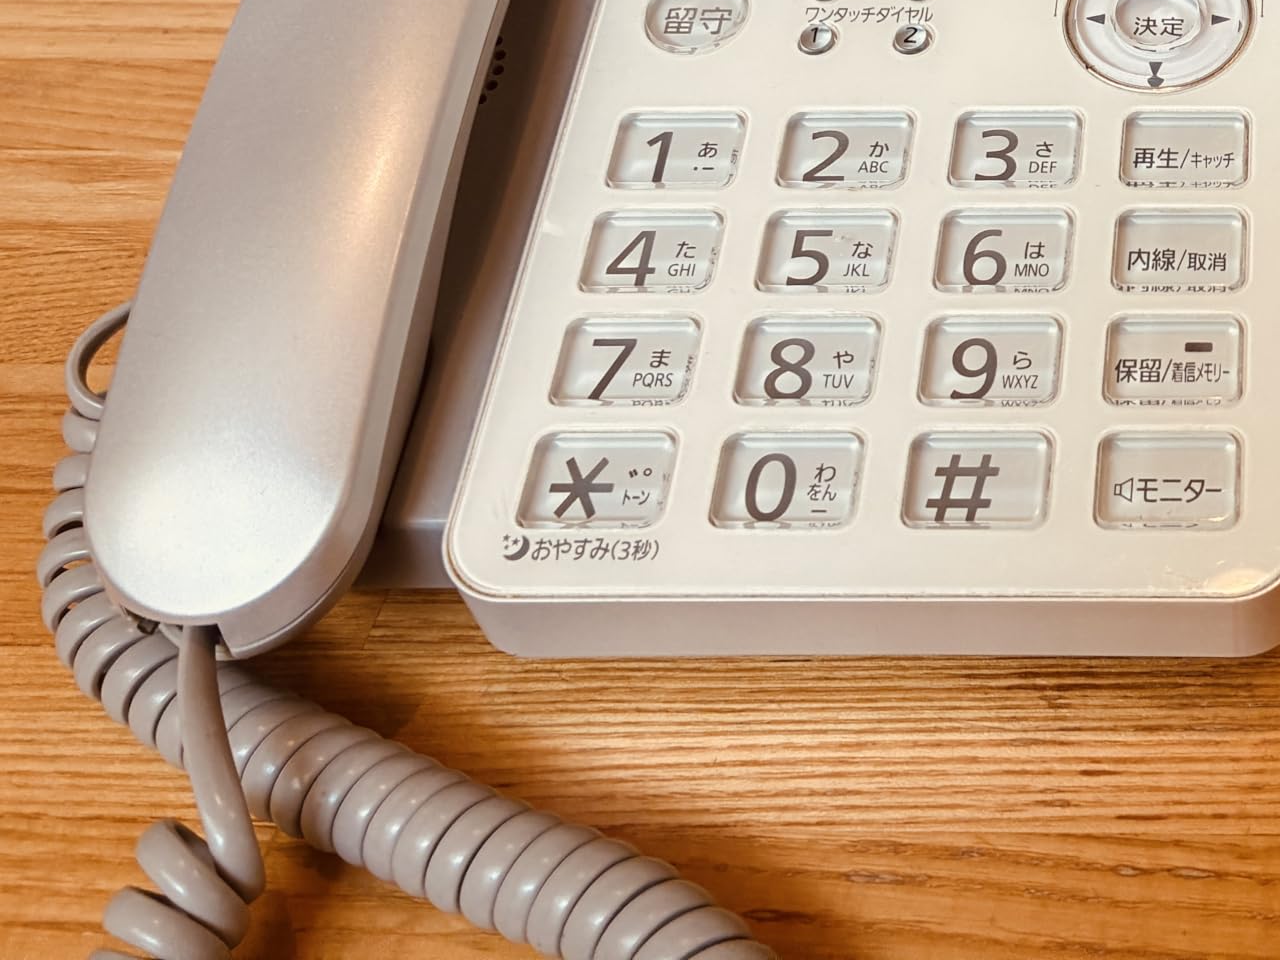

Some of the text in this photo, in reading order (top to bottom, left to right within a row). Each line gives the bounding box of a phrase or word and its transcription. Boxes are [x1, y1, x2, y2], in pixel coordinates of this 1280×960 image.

[664, 6, 732, 34] 留守
[804, 6, 933, 23] ワンタッチダイヤル
[810, 27, 819, 43] 1
[903, 27, 918, 43] 2
[1132, 16, 1185, 37] 決定
[646, 131, 674, 183] 1
[698, 142, 718, 158] あ
[802, 130, 850, 182] 2
[869, 141, 889, 158] か
[974, 129, 1019, 181] 3
[1035, 141, 1054, 158] さ
[1132, 147, 1235, 170] 再生/キャッチ
[858, 160, 889, 174] ABC
[1028, 160, 1057, 174] DEF
[605, 230, 656, 286] 4
[676, 241, 696, 259] た
[786, 229, 833, 286] 5
[852, 241, 873, 259] な
[963, 229, 1007, 286] 6
[1023, 241, 1046, 260] は
[1127, 248, 1227, 272] 内線/取消
[667, 263, 696, 277] GHI
[843, 263, 870, 278] JKL
[1014, 263, 1049, 277] MNO
[649, 349, 671, 368] ま
[833, 350, 854, 369] や
[1012, 351, 1032, 370] ら
[587, 338, 637, 399] 7
[764, 338, 816, 399] 8
[950, 338, 998, 399] 9
[1114, 358, 1230, 383] 保留/着信メモリー
[632, 372, 673, 389] PQRS
[822, 374, 854, 389] TUV
[1002, 374, 1039, 390] WXYZ
[814, 463, 836, 482] わ
[744, 452, 797, 521] 0
[1136, 478, 1222, 503] モニター
[622, 489, 651, 505] トーン
[531, 537, 660, 561] おやすみ(3秒)
